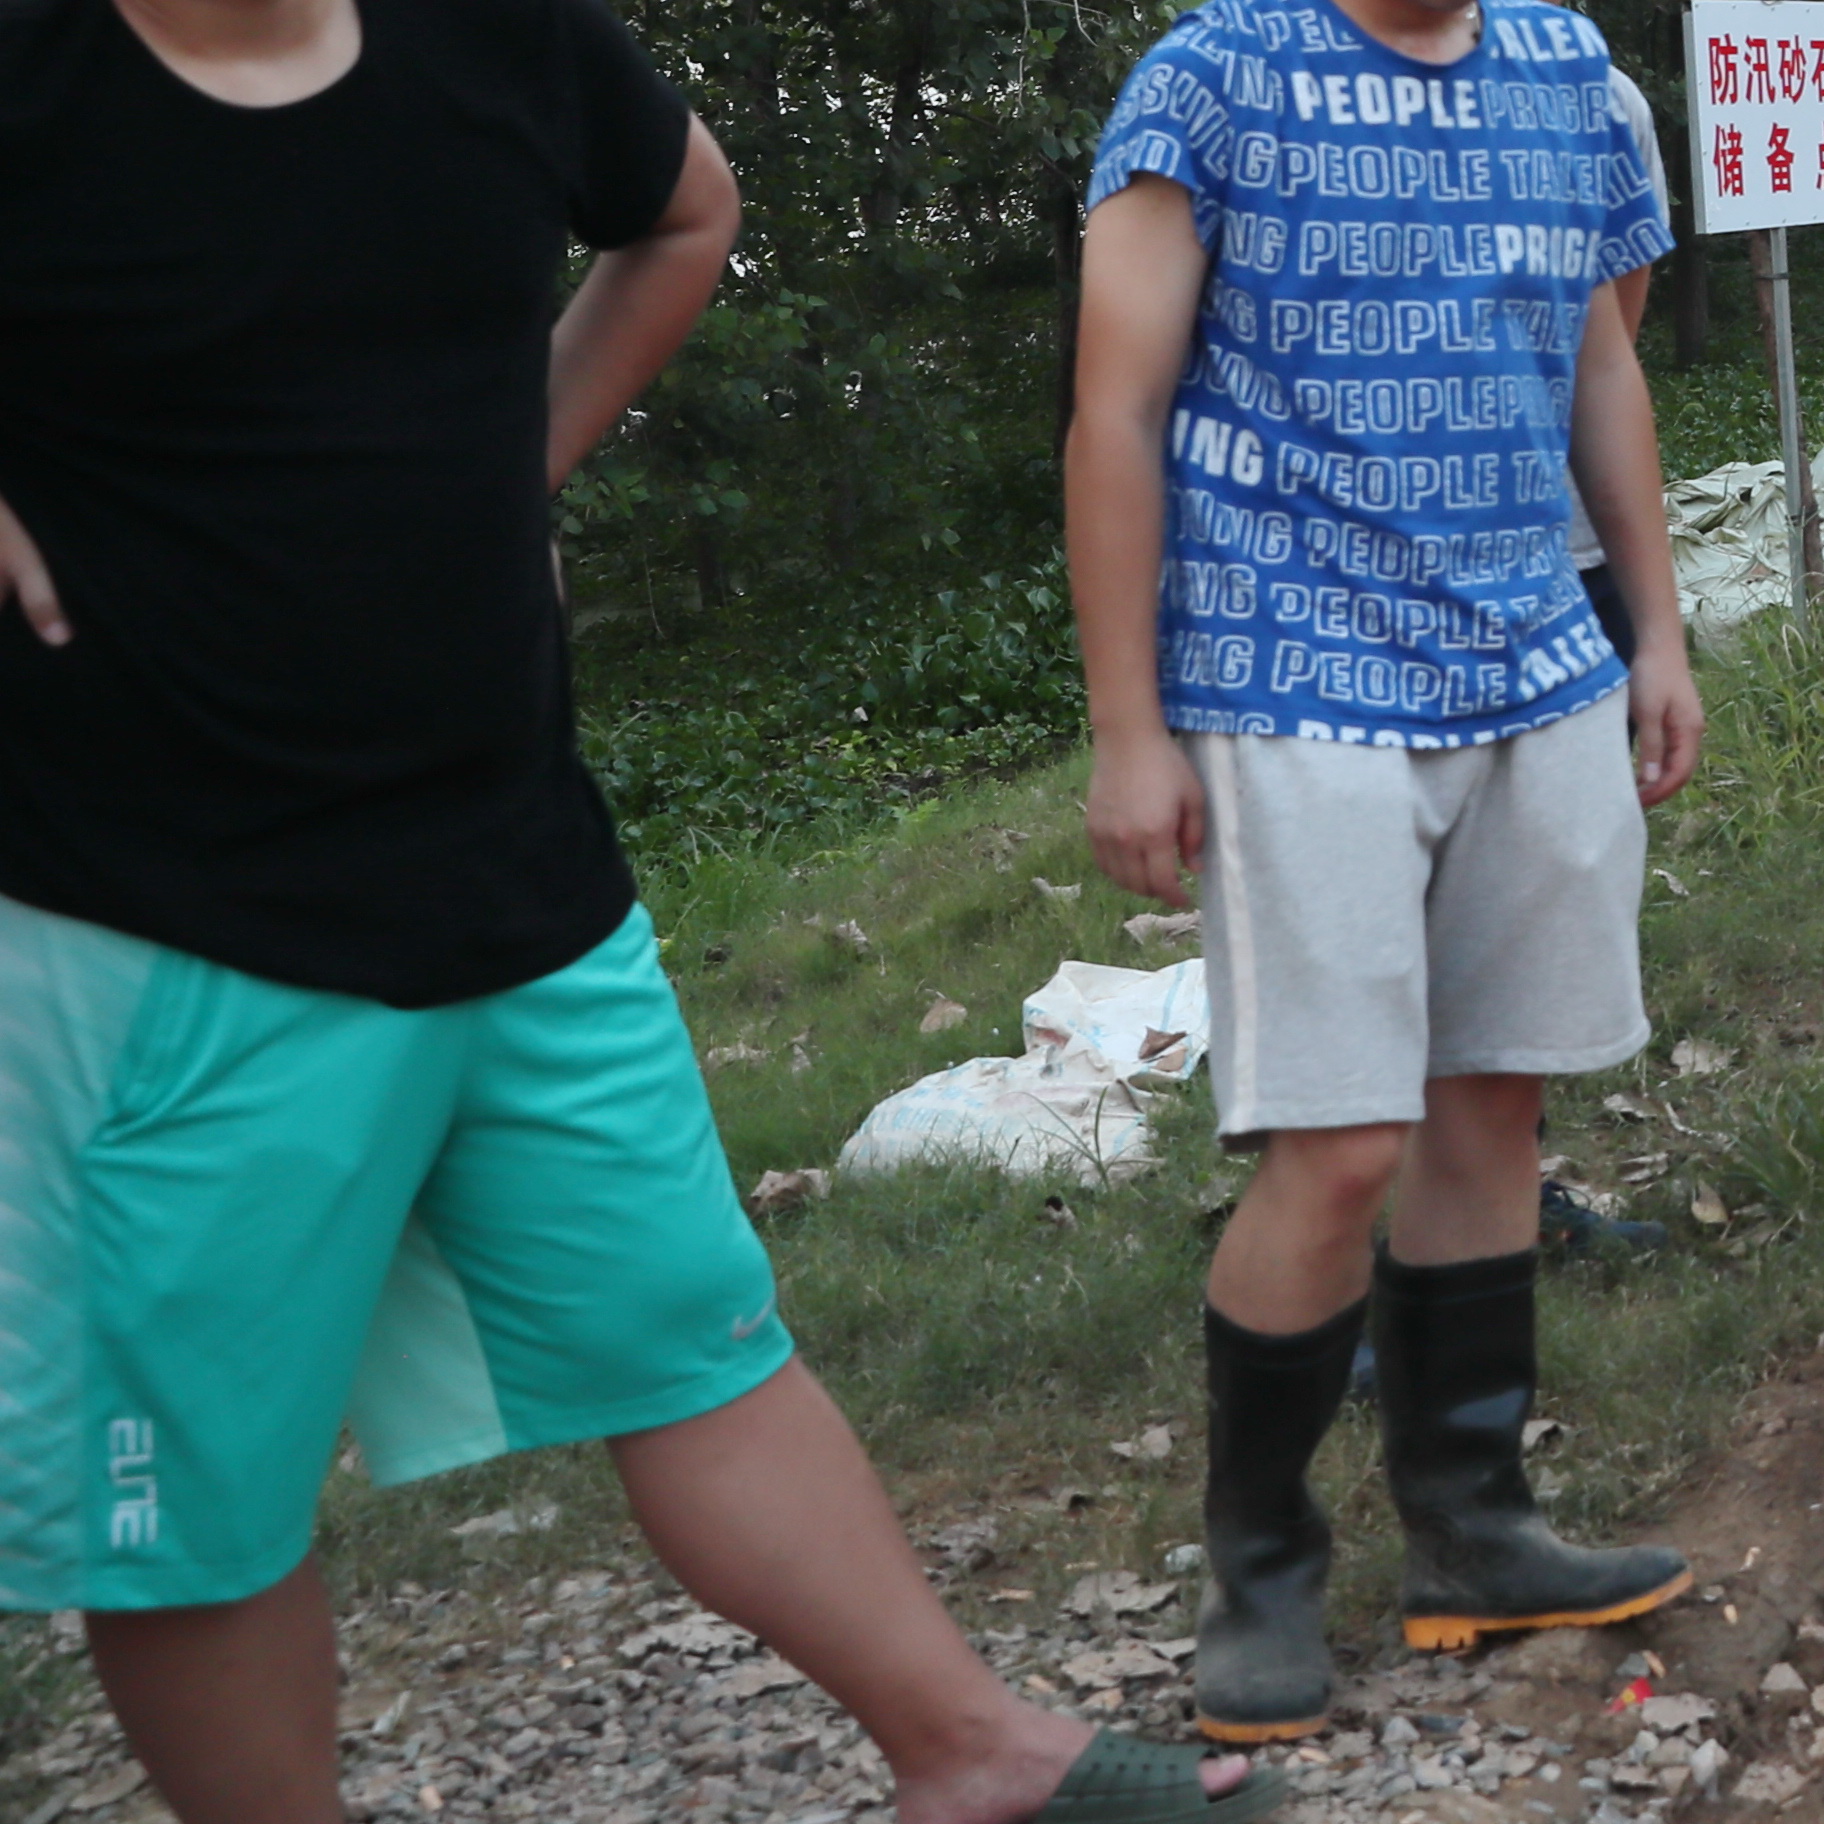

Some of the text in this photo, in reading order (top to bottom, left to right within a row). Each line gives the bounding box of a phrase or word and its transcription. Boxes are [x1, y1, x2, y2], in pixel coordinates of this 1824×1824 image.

[1291, 72, 1482, 130] PEOPLE
[1277, 142, 1492, 202] PEOPLE
[1299, 221, 1497, 278] PEOPLE
[1271, 298, 1496, 356] PEOPLE
[1295, 377, 1498, 434] PEOPLE
[1173, 408, 1264, 488] ING
[1276, 440, 1499, 512] PEOPLE
[1303, 517, 1498, 586] PEOPLE
[1269, 581, 1507, 650] PEOPLE
[1270, 639, 1507, 717] PEOPLE
